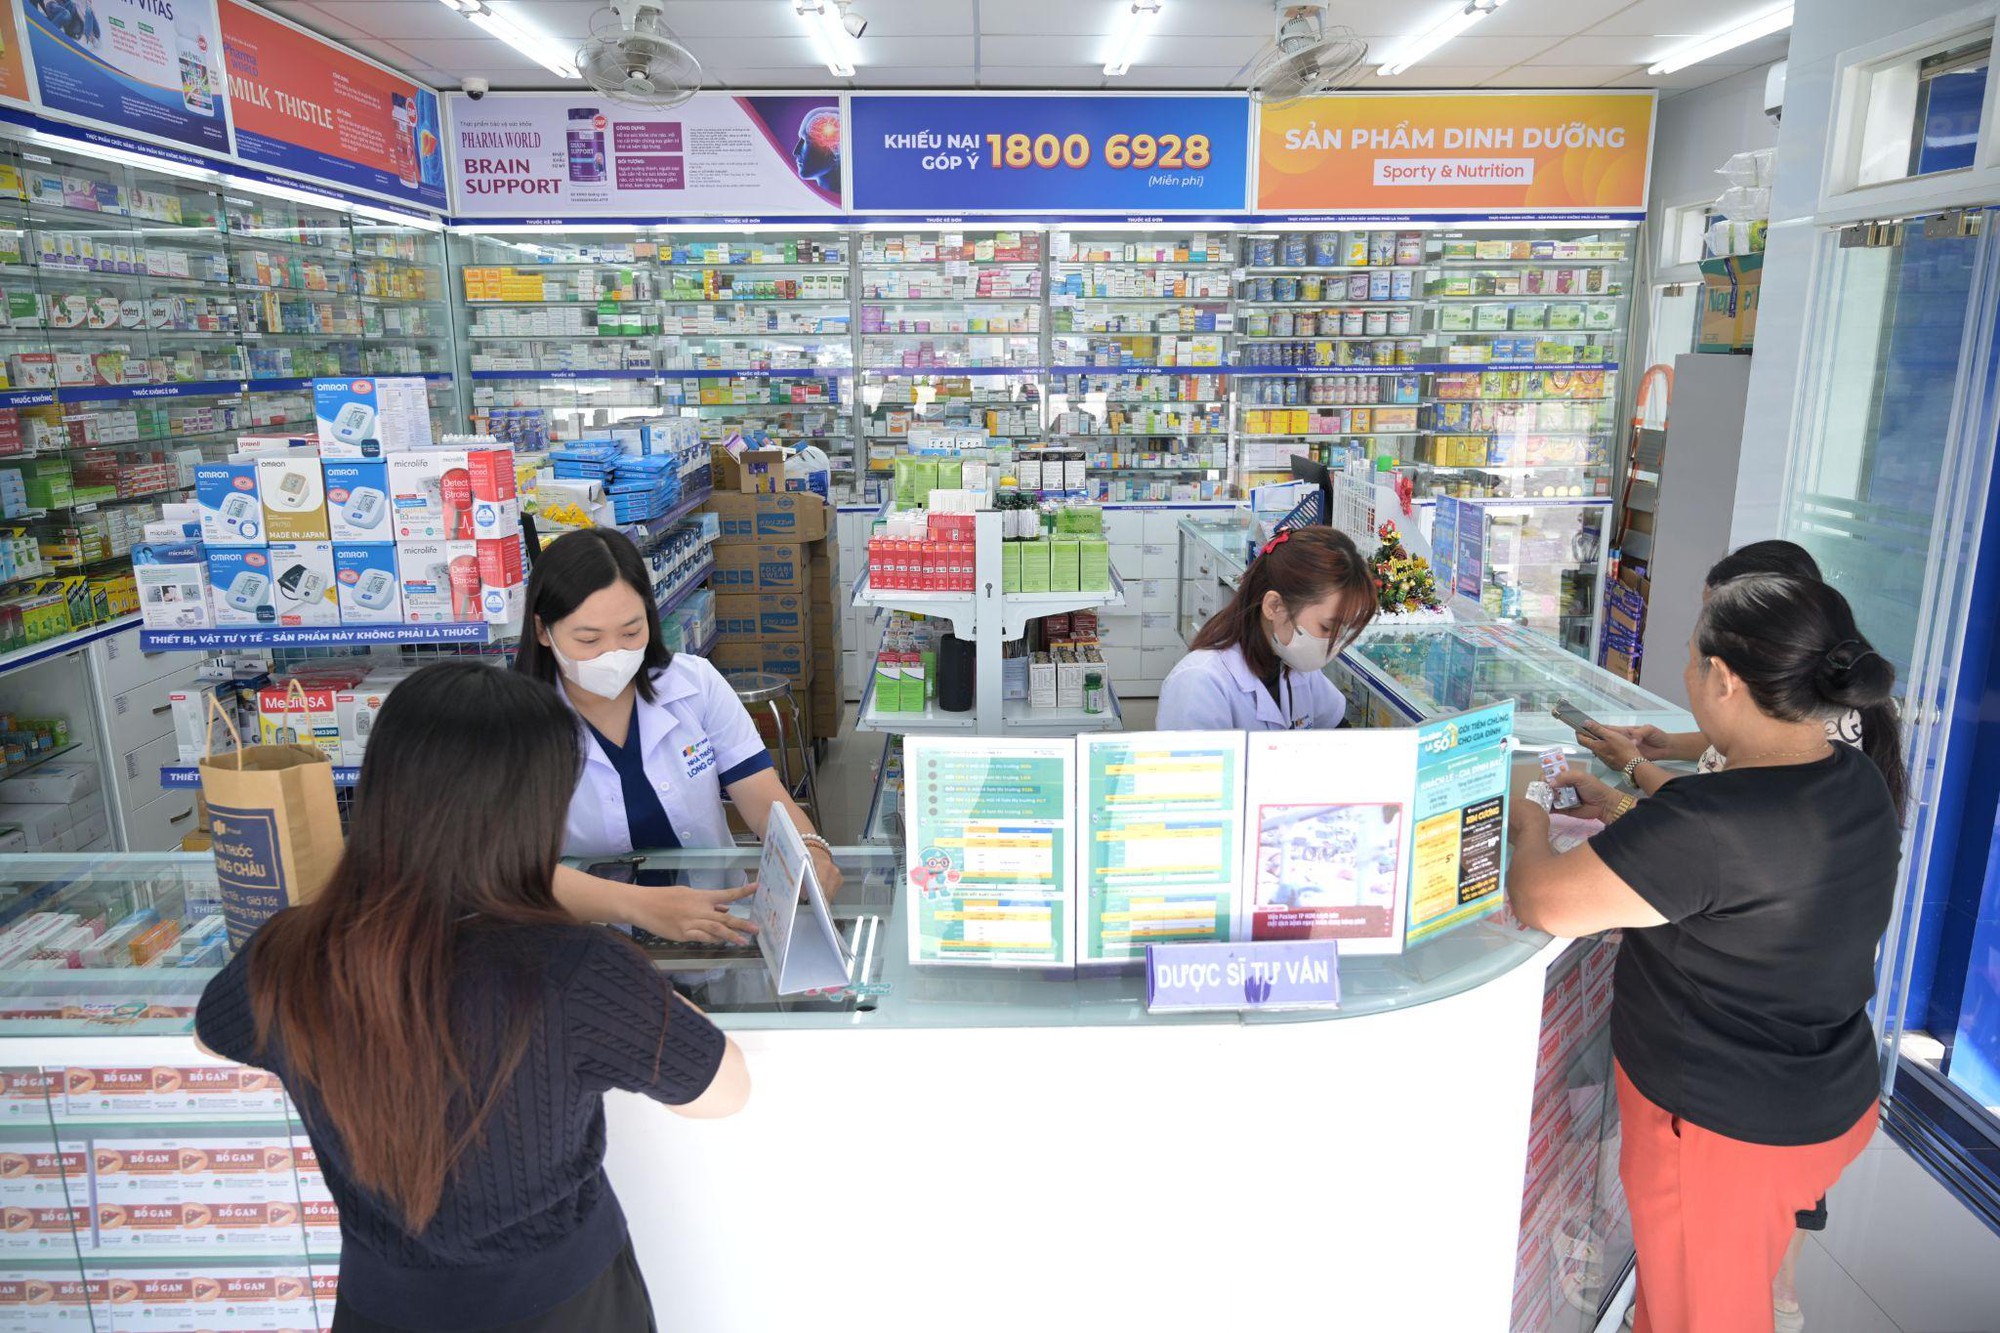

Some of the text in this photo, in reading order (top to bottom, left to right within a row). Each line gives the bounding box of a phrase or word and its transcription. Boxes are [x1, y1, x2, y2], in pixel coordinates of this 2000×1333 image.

[228, 74, 272, 110] MILK
[274, 90, 334, 130] THISTLE
[462, 132, 541, 148] PHARMA WORLD
[1285, 120, 1626, 150] SẢN PHẨM DINH DƯỠNG
[884, 129, 980, 153] KHIẾU NẠI
[987, 133, 1212, 169] 1800 6928
[464, 159, 530, 174] BRAIN
[922, 153, 980, 170] GÓP Ý
[1382, 164, 1525, 182] Sporty & Nutrition
[466, 178, 562, 194] SUPPORT
[1148, 174, 1204, 188] (Miễn phí)
[316, 383, 348, 392] OMRON
[394, 460, 428, 469] microlife
[198, 471, 229, 479] OMRON
[443, 479, 468, 487] Detect
[444, 490, 470, 499] Stroke
[168, 549, 195, 557] microlife
[404, 546, 438, 555] microlife
[210, 554, 242, 562] OMRON
[453, 577, 478, 585] Stroke
[150, 634, 181, 644] THIẾT
[183, 635, 197, 646] BỊ,
[199, 634, 221, 645] VẬT
[223, 634, 238, 643] TƯ
[240, 635, 248, 643] Y
[249, 632, 263, 643] TẾ
[272, 632, 296, 642] SẢN
[298, 629, 330, 641] PHẨM
[331, 630, 355, 640] NÀY
[356, 629, 395, 640] KHÔNG
[398, 628, 424, 638] PHẢI
[426, 628, 439, 637] LÀ
[442, 625, 479, 636] THUỐC
[687, 762, 708, 779] LONG
[171, 772, 200, 782] THIẾT
[225, 842, 254, 858] THUỐC
[233, 860, 266, 878] CHÂU
[1157, 954, 1328, 993] DƯỢC SĨ TƯ VẤN
[30, 1076, 54, 1086] GAN
[120, 1073, 143, 1083] GAN
[206, 1072, 229, 1082] GAN
[53, 1157, 77, 1167] GAN
[147, 1154, 170, 1163] GAN
[232, 1153, 255, 1163] GAN
[58, 1212, 80, 1222] GAN
[150, 1208, 173, 1218] GAN
[235, 1208, 257, 1217] GAN
[77, 1284, 99, 1294] GAN
[161, 1283, 183, 1292] GAN
[244, 1282, 266, 1291] GAN
[327, 1280, 339, 1289] GA
